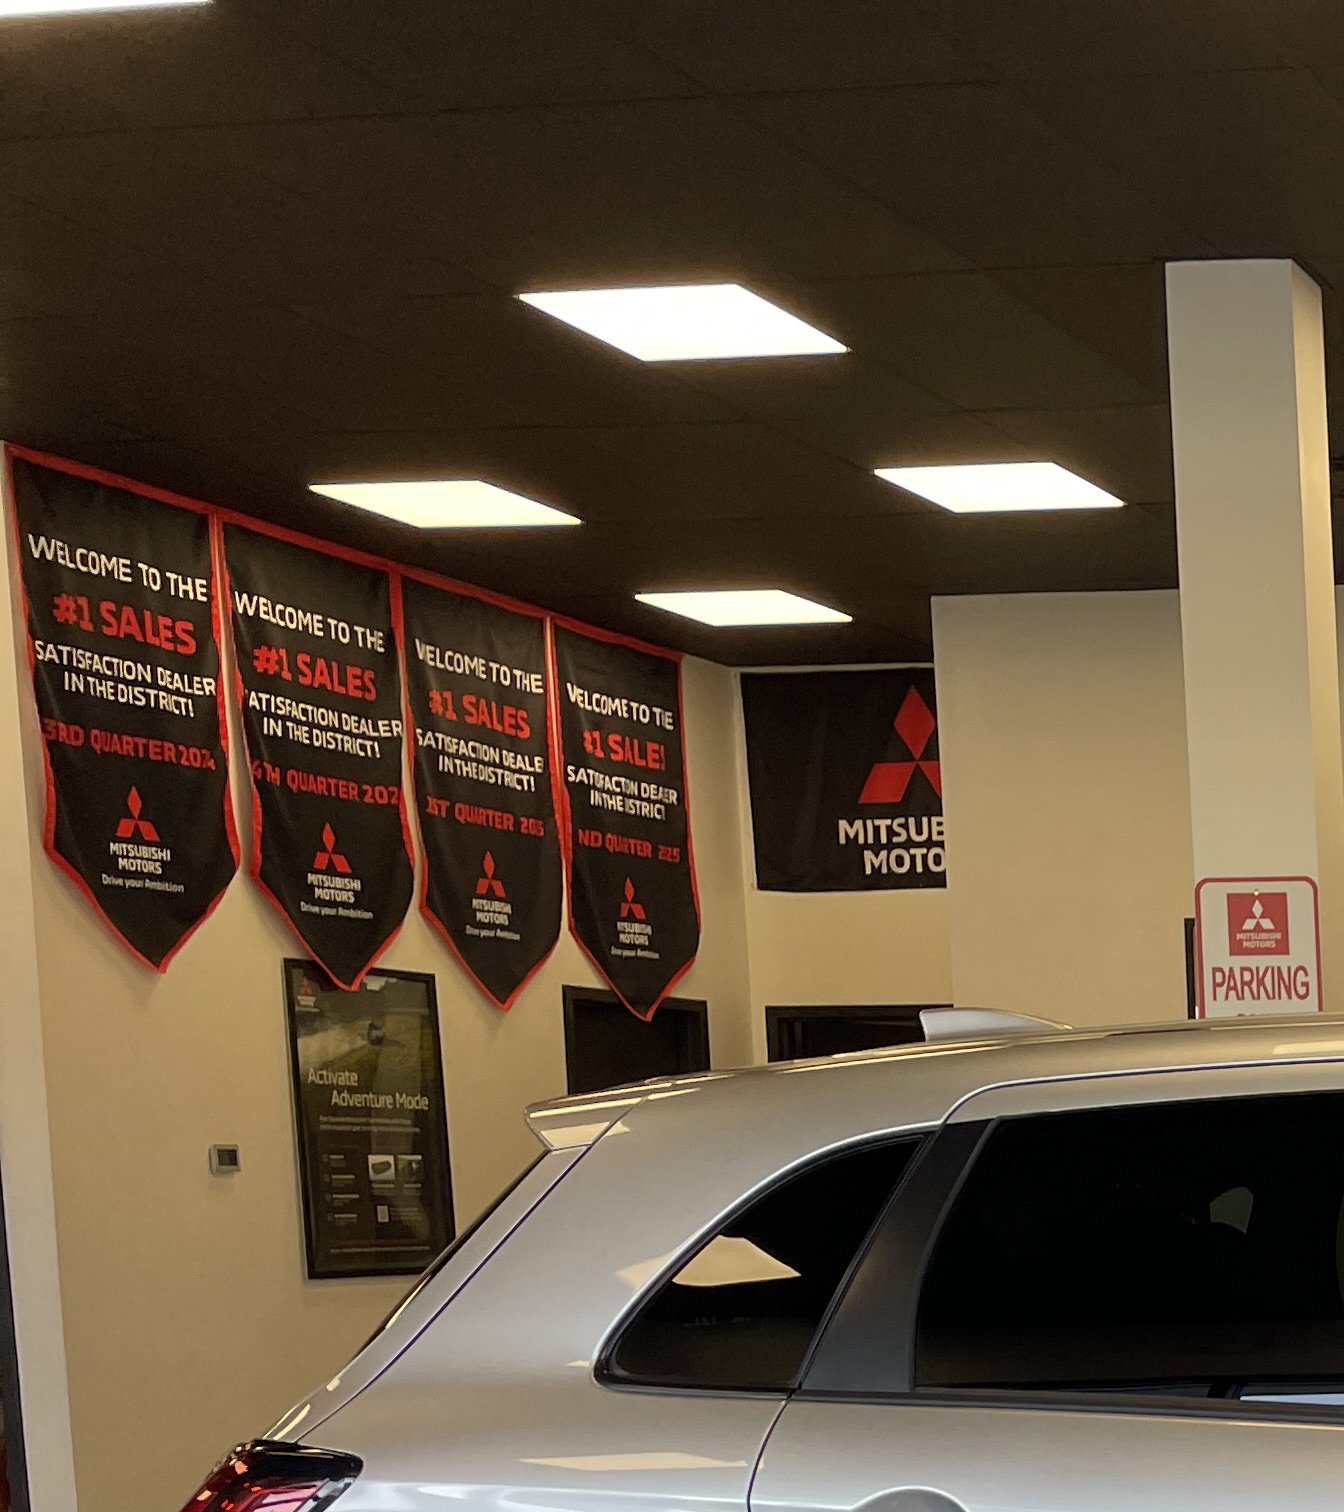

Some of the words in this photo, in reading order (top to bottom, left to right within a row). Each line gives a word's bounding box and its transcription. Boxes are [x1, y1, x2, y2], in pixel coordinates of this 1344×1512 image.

[27, 533, 133, 583] WELCOME
[137, 562, 162, 591] TO
[165, 571, 208, 602] THE
[52, 593, 94, 632] #1
[99, 600, 197, 655] SALES
[234, 591, 324, 637] WELCOME
[327, 617, 350, 644] TO
[353, 624, 385, 653] THE
[34, 640, 151, 684] SATISFACTION
[157, 666, 216, 697] DEALER
[252, 645, 293, 682] #1
[296, 652, 377, 701] SALES
[488, 661, 511, 686] TO
[512, 669, 544, 694] THE
[63, 671, 85, 693] IN
[86, 676, 115, 700] THE
[117, 683, 195, 718] DISTRICT!
[629, 701, 650, 724] TO
[245, 688, 339, 729] ATISFACTION
[341, 712, 403, 738] DEALER
[428, 689, 457, 721] #1
[462, 694, 531, 739] SALES
[90, 729, 177, 764] QUARTER
[263, 717, 282, 737] IN
[286, 721, 311, 745] THE
[313, 728, 381, 759] DISTRICT!
[415, 728, 500, 764] SATISFACTION
[607, 733, 665, 771] SALE
[286, 769, 359, 801] QUARTER
[438, 755, 454, 774] IN
[454, 758, 478, 779] THE
[479, 764, 535, 792] DISTRICT!
[109, 841, 171, 862] MITSUBISHI
[118, 857, 162, 875] MOTORS
[307, 872, 361, 891] MITSUBISHI
[314, 887, 355, 903] MOTORS
[1236, 931, 1282, 941] MITSUBISHI
[1242, 940, 1276, 948] MOTORS
[1211, 965, 1310, 1001] PARKING
[307, 1067, 358, 1086] Activate
[331, 1089, 393, 1109] Adventure
[395, 1092, 429, 1110] Mode
